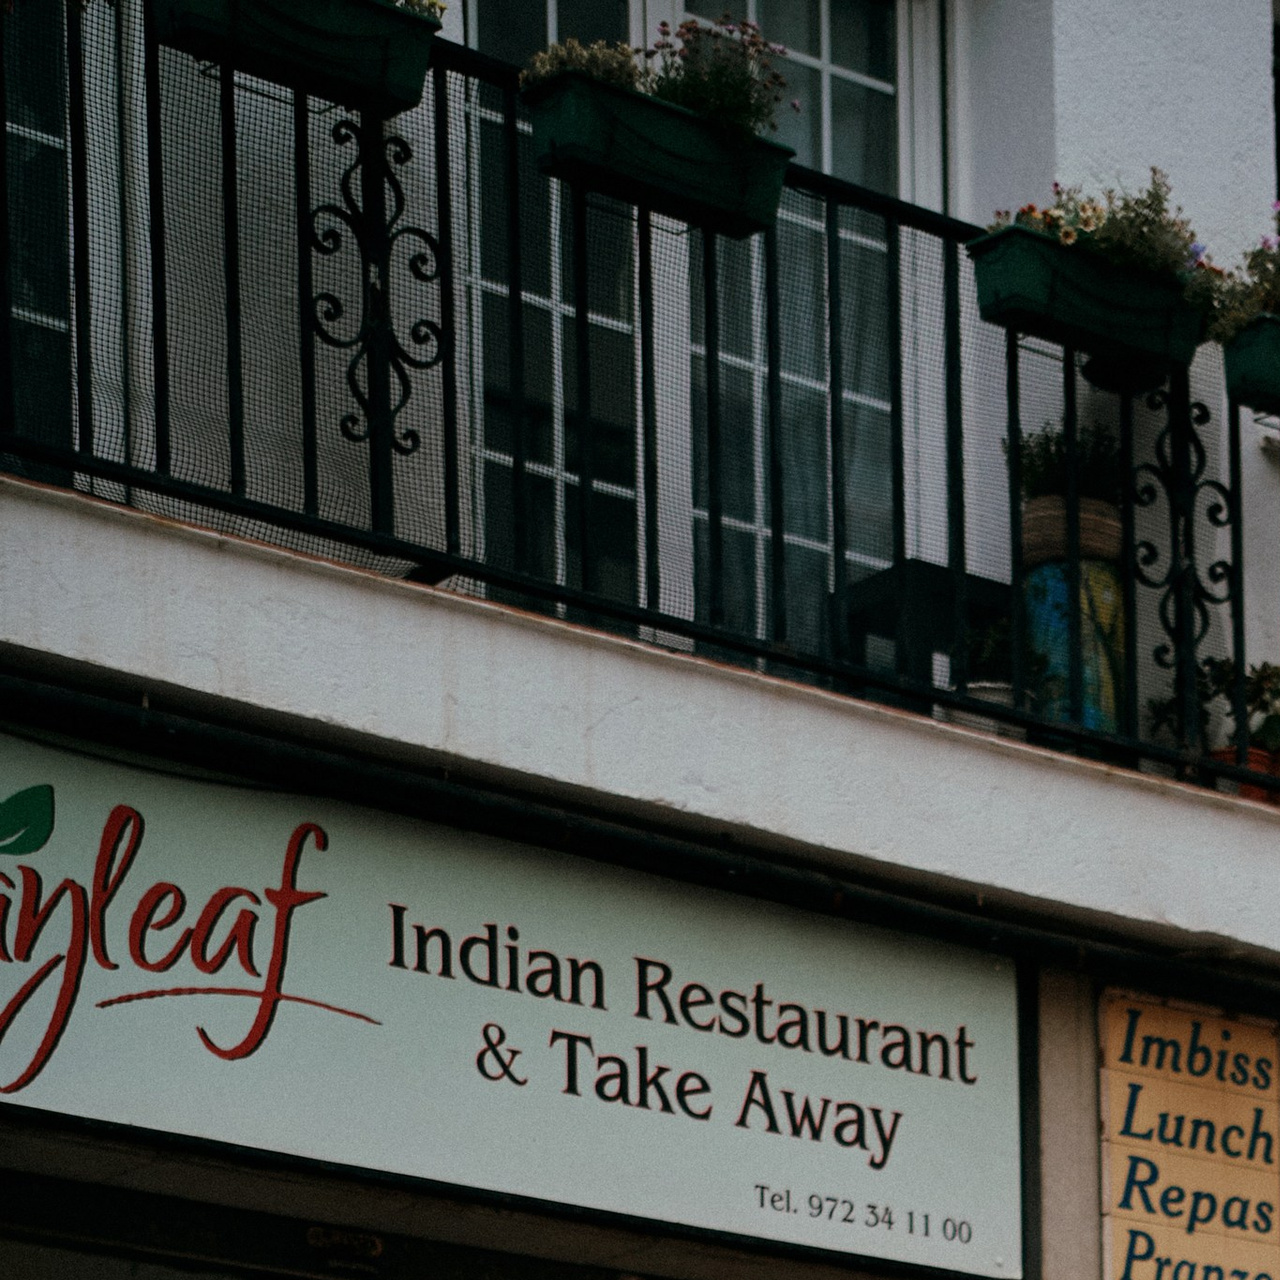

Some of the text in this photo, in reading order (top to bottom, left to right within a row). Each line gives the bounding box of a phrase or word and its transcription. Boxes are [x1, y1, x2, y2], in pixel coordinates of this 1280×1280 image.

[0, 804, 329, 1094] yleaf
[387, 902, 977, 1085] Indian Restaurant
[1118, 1008, 1274, 1091] Imbiss
[476, 1022, 904, 1171] & Take Away
[1118, 1082, 1275, 1165] Lunch
[755, 1184, 973, 1244] Tel. 972 34 11 00
[1117, 1154, 1275, 1234] Repas
